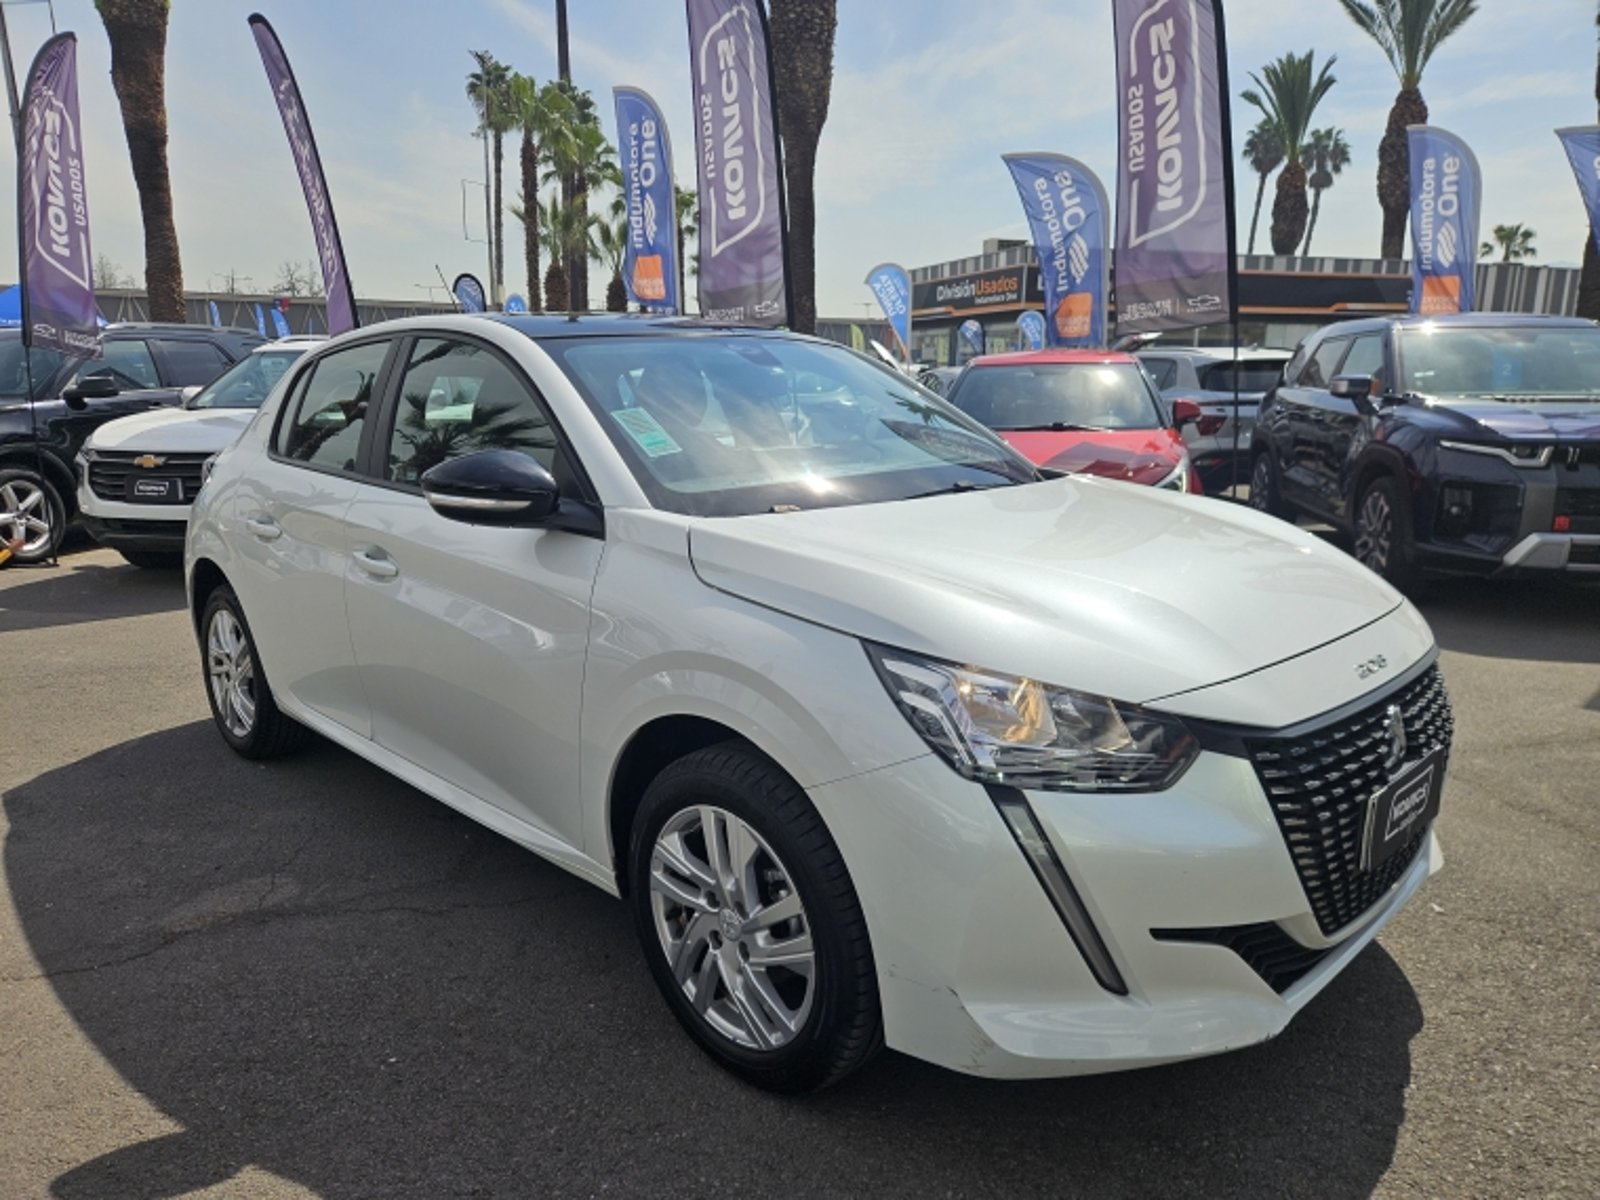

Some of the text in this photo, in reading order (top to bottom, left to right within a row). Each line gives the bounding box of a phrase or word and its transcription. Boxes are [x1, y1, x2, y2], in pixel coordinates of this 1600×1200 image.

[44, 108, 70, 257] KOVACS
[640, 119, 656, 187] One
[1438, 155, 1461, 216] One
[69, 157, 87, 227] USADOS
[1054, 170, 1086, 230] One
[1420, 157, 1437, 270] Indumotora
[1033, 177, 1068, 291] Indumotora
